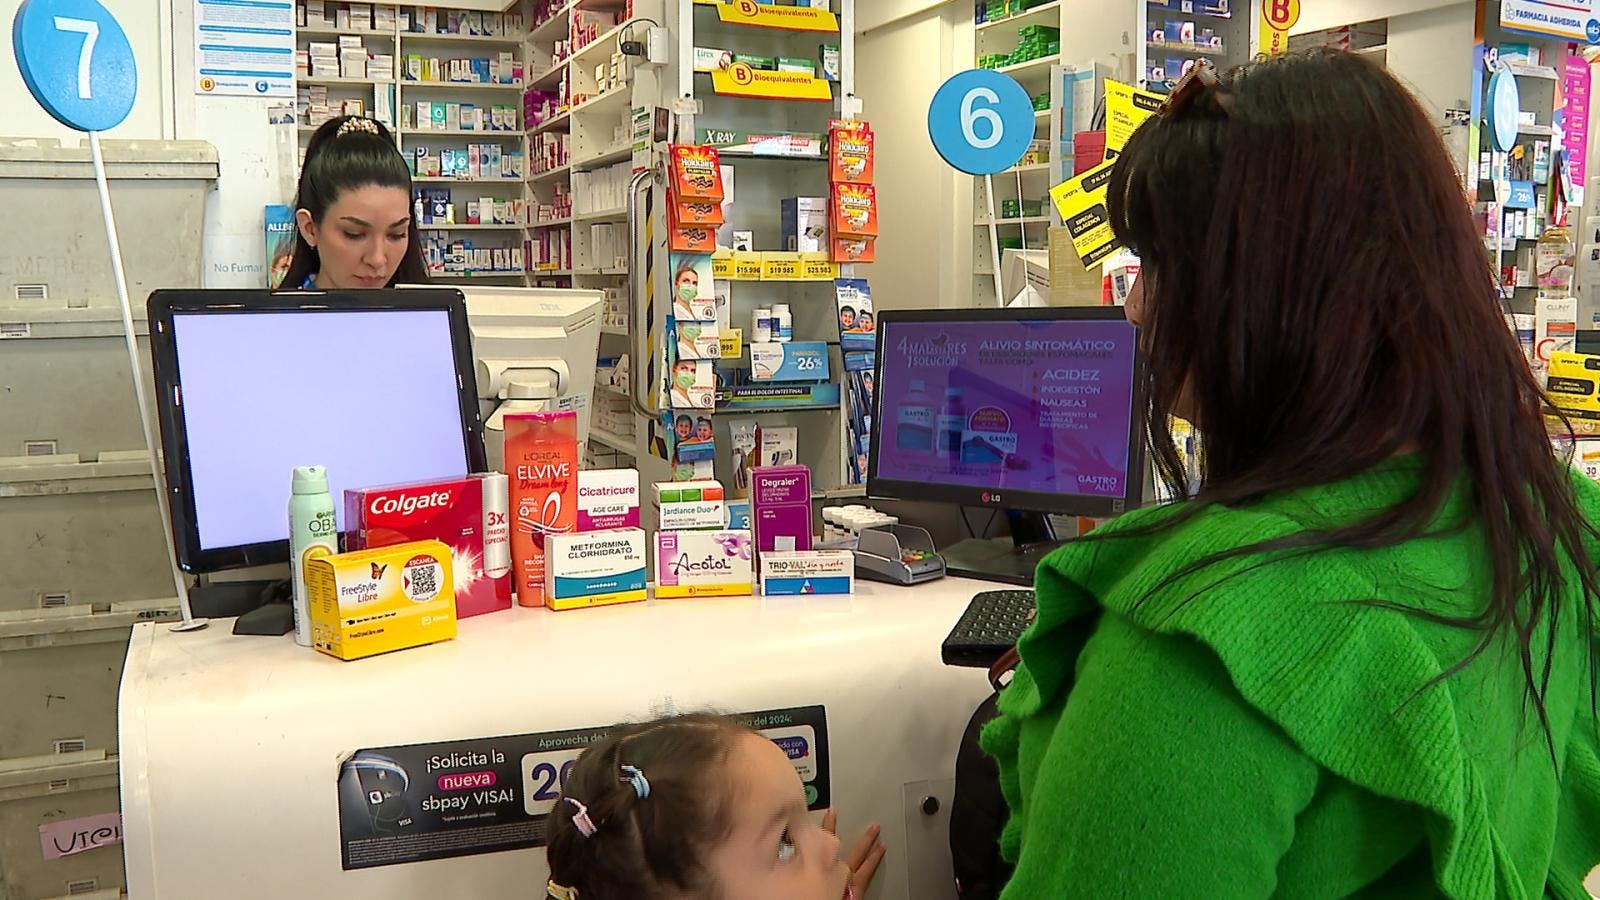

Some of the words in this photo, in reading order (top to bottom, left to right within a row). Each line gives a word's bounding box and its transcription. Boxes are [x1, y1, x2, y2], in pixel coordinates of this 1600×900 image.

[760, 7, 818, 18] Bioequivalentes
[1516, 9, 1549, 22] FARMACIA
[1550, 15, 1582, 28] ADHERIDA
[53, 16, 100, 99] 7
[754, 73, 812, 85] Bioequivalentes
[960, 87, 1004, 149] 6
[214, 263, 229, 273] No
[231, 263, 263, 273] Fumar
[897, 336, 909, 356] 4
[980, 340, 1022, 351] ALIVIO
[1025, 338, 1115, 351] SINTOMÁTICO
[797, 357, 823, 371] 26%
[1042, 369, 1101, 381] ACIDEZ
[1041, 398, 1088, 408] NAUSEAS
[518, 462, 570, 480] ELVIVE
[1586, 467, 1597, 475] 30
[762, 478, 795, 488] Degraler
[1078, 475, 1117, 485] GASTRO
[579, 486, 635, 497] Cicatricure
[371, 493, 449, 515] Colgate
[991, 494, 1001, 502] LG
[607, 505, 624, 513] CARE
[663, 506, 696, 516] Jardiance
[488, 512, 505, 526] 3x
[487, 528, 506, 536] PRECIO
[570, 540, 631, 551] METFORMINA
[568, 547, 633, 559] CLORHIDRATO
[409, 557, 435, 567] ESCANEA
[769, 560, 806, 569] TRIO-VAL
[341, 582, 378, 596] FreeStyle
[358, 593, 379, 604] Libre
[754, 715, 767, 726] del
[539, 734, 589, 749] Aprovecha
[426, 752, 489, 774] ¡Solicita
[491, 749, 505, 765] la
[443, 775, 490, 789] nueva
[422, 794, 470, 812] sbpay
[473, 788, 514, 806] VISA!
